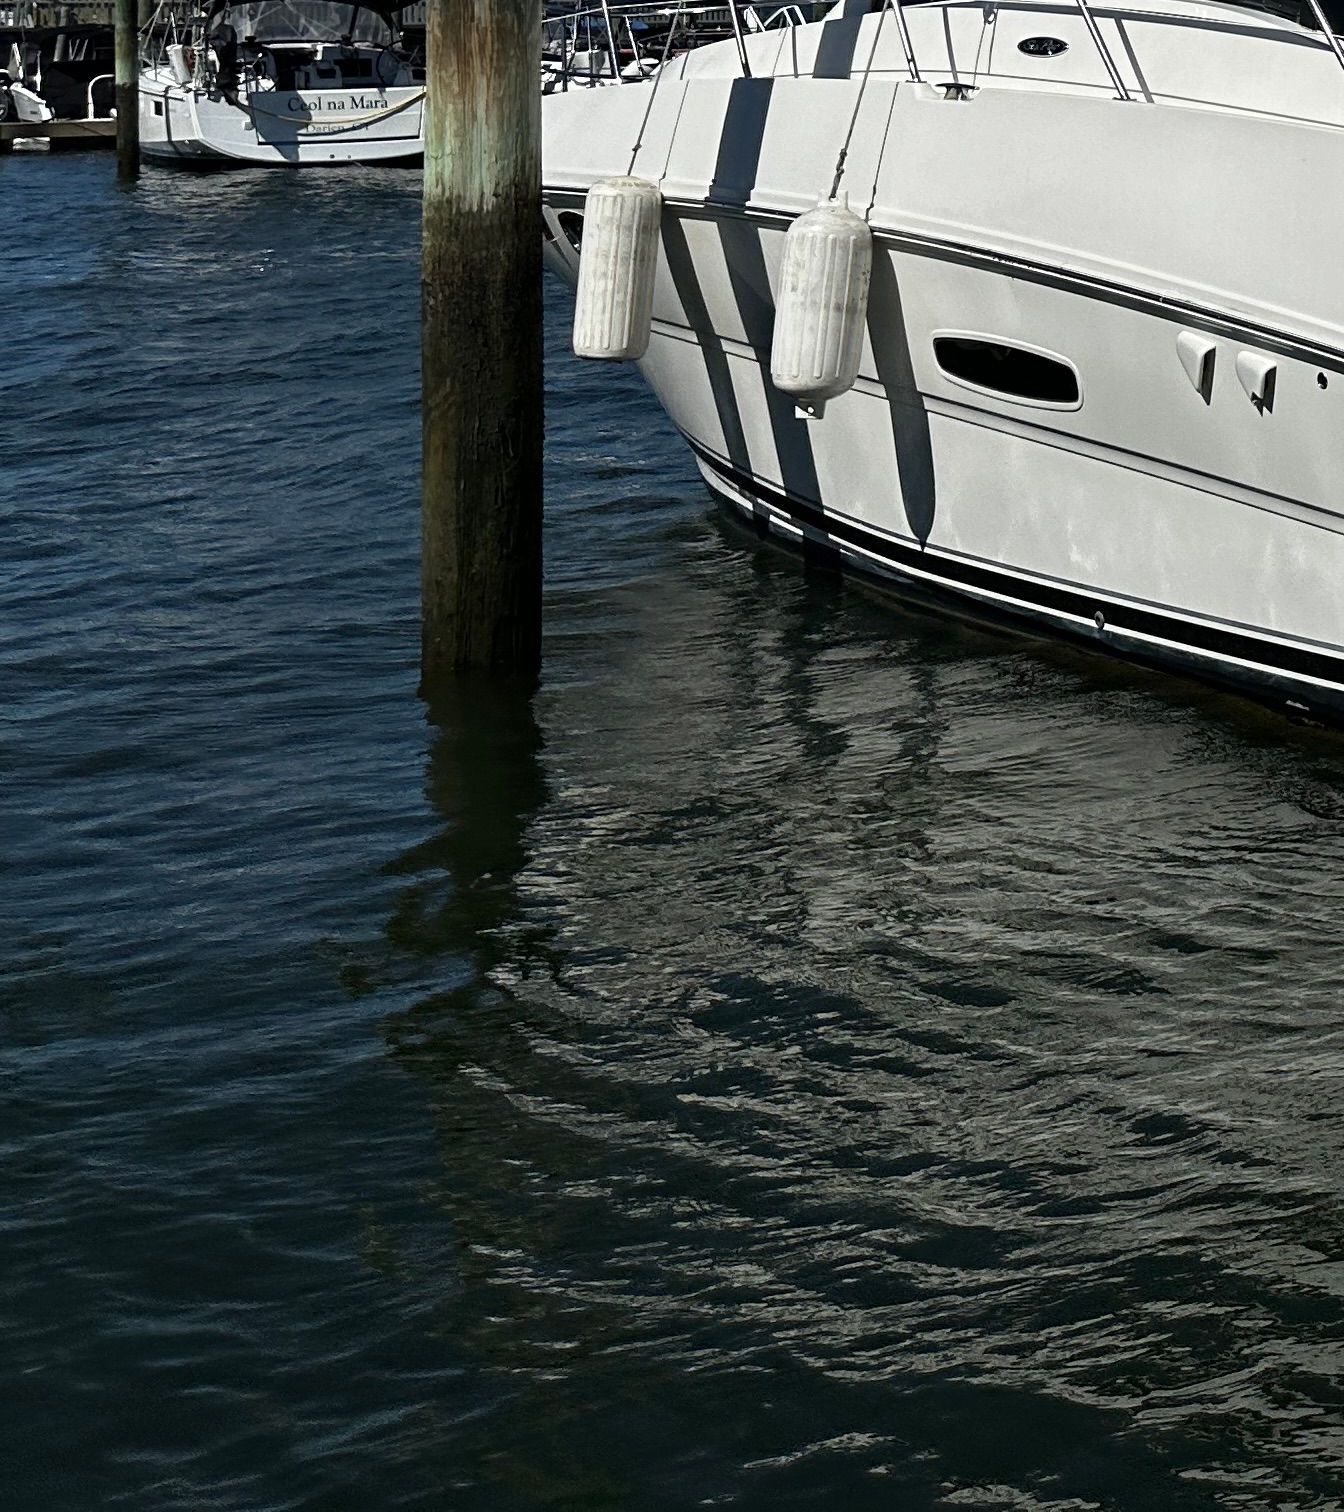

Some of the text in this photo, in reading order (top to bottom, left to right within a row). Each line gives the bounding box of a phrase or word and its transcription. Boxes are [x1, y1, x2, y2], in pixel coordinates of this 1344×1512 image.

[287, 96, 389, 112] Ceol na Mara
